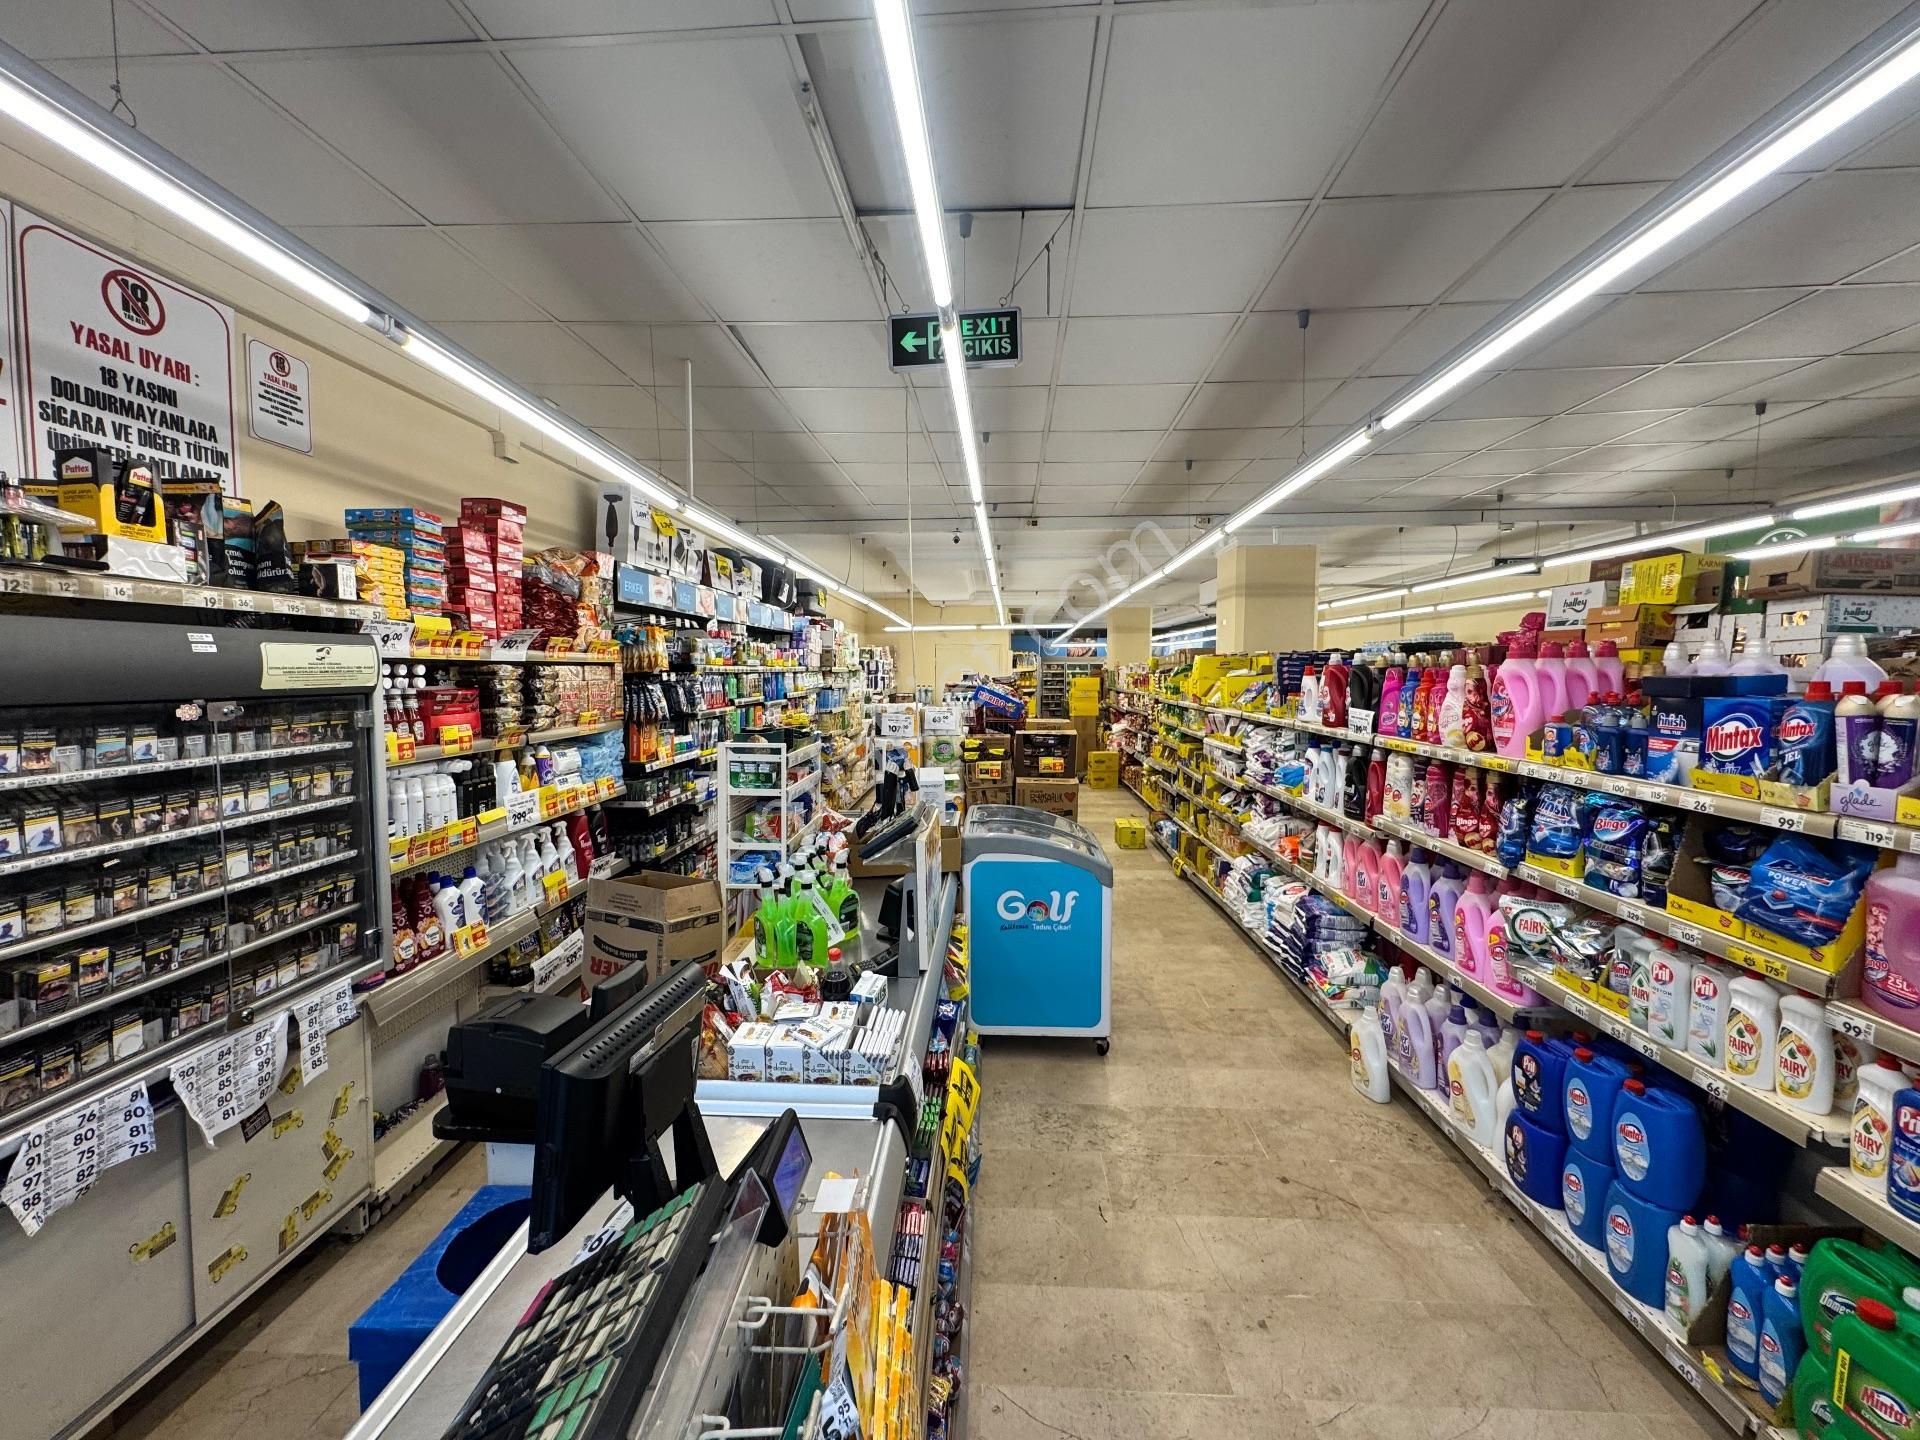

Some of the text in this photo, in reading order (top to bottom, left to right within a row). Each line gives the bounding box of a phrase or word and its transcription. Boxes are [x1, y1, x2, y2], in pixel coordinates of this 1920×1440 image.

[962, 317, 1011, 336] EXIT
[70, 321, 135, 364] YASAL
[963, 338, 1012, 357] ÇIKIŞ
[100, 366, 178, 408] 18 YAŞINI
[51, 376, 217, 443] DOLDURMAYANLARA
[39, 396, 230, 469] SİGARA VE DİĞER TÜTÜN
[64, 464, 90, 474] Pattex
[2, 579, 21, 592] 12
[59, 582, 71, 592] 12
[114, 587, 126, 596] 16
[625, 581, 644, 595] ERKEK
[204, 597, 216, 607] 19
[287, 604, 300, 613] 195
[1563, 597, 1587, 613] halley
[1844, 607, 1872, 621] halley
[978, 690, 1005, 707] HARIBO
[1658, 712, 1687, 731] finish
[1705, 724, 1762, 754] Mintax
[1779, 722, 1816, 739] Mintax
[1783, 751, 1801, 764] JEL
[1574, 776, 1584, 785] 25
[1612, 785, 1625, 793] 100
[1693, 800, 1707, 812] 26
[1840, 791, 1881, 813] glade
[1456, 817, 1478, 826] Bingo
[1594, 818, 1628, 831] Bingo
[1768, 871, 1808, 889] POWER
[997, 890, 1079, 923] Golf
[1032, 923, 1052, 931] Tadını
[1681, 931, 1695, 942] 105
[1652, 965, 1670, 982] Pril
[1765, 965, 1780, 976] 175
[336, 990, 347, 1001] 85
[1694, 978, 1714, 996] Pril
[308, 1003, 348, 1016] 82 82
[255, 1029, 268, 1041] 87
[308, 1030, 319, 1042] 88
[1610, 1027, 1621, 1038] 53
[218, 1043, 270, 1061] 84 87
[310, 1044, 320, 1055] 85
[1728, 1034, 1754, 1056] FAIRY
[218, 1057, 271, 1076] 85 89
[311, 1057, 322, 1069] 85
[1779, 1055, 1808, 1078] FAIRY
[218, 1072, 271, 1090] 85 80
[1706, 1082, 1721, 1097] 66
[217, 1091, 233, 1107] 80
[1567, 1087, 1588, 1106] Mintax
[78, 1106, 145, 1127] 76 80
[222, 1107, 236, 1120] 81
[73, 1123, 147, 1146] 80 81
[1619, 1122, 1644, 1143] Mintax
[1853, 1130, 1883, 1155] FAIRY
[77, 1146, 95, 1164] 75
[129, 1141, 149, 1157] 75
[25, 1153, 95, 1183] 91 82
[22, 1172, 42, 1191] 97
[22, 1192, 41, 1212] 88
[1609, 1213, 1632, 1237] Mintax
[1861, 1385, 1913, 1430] Mintax
